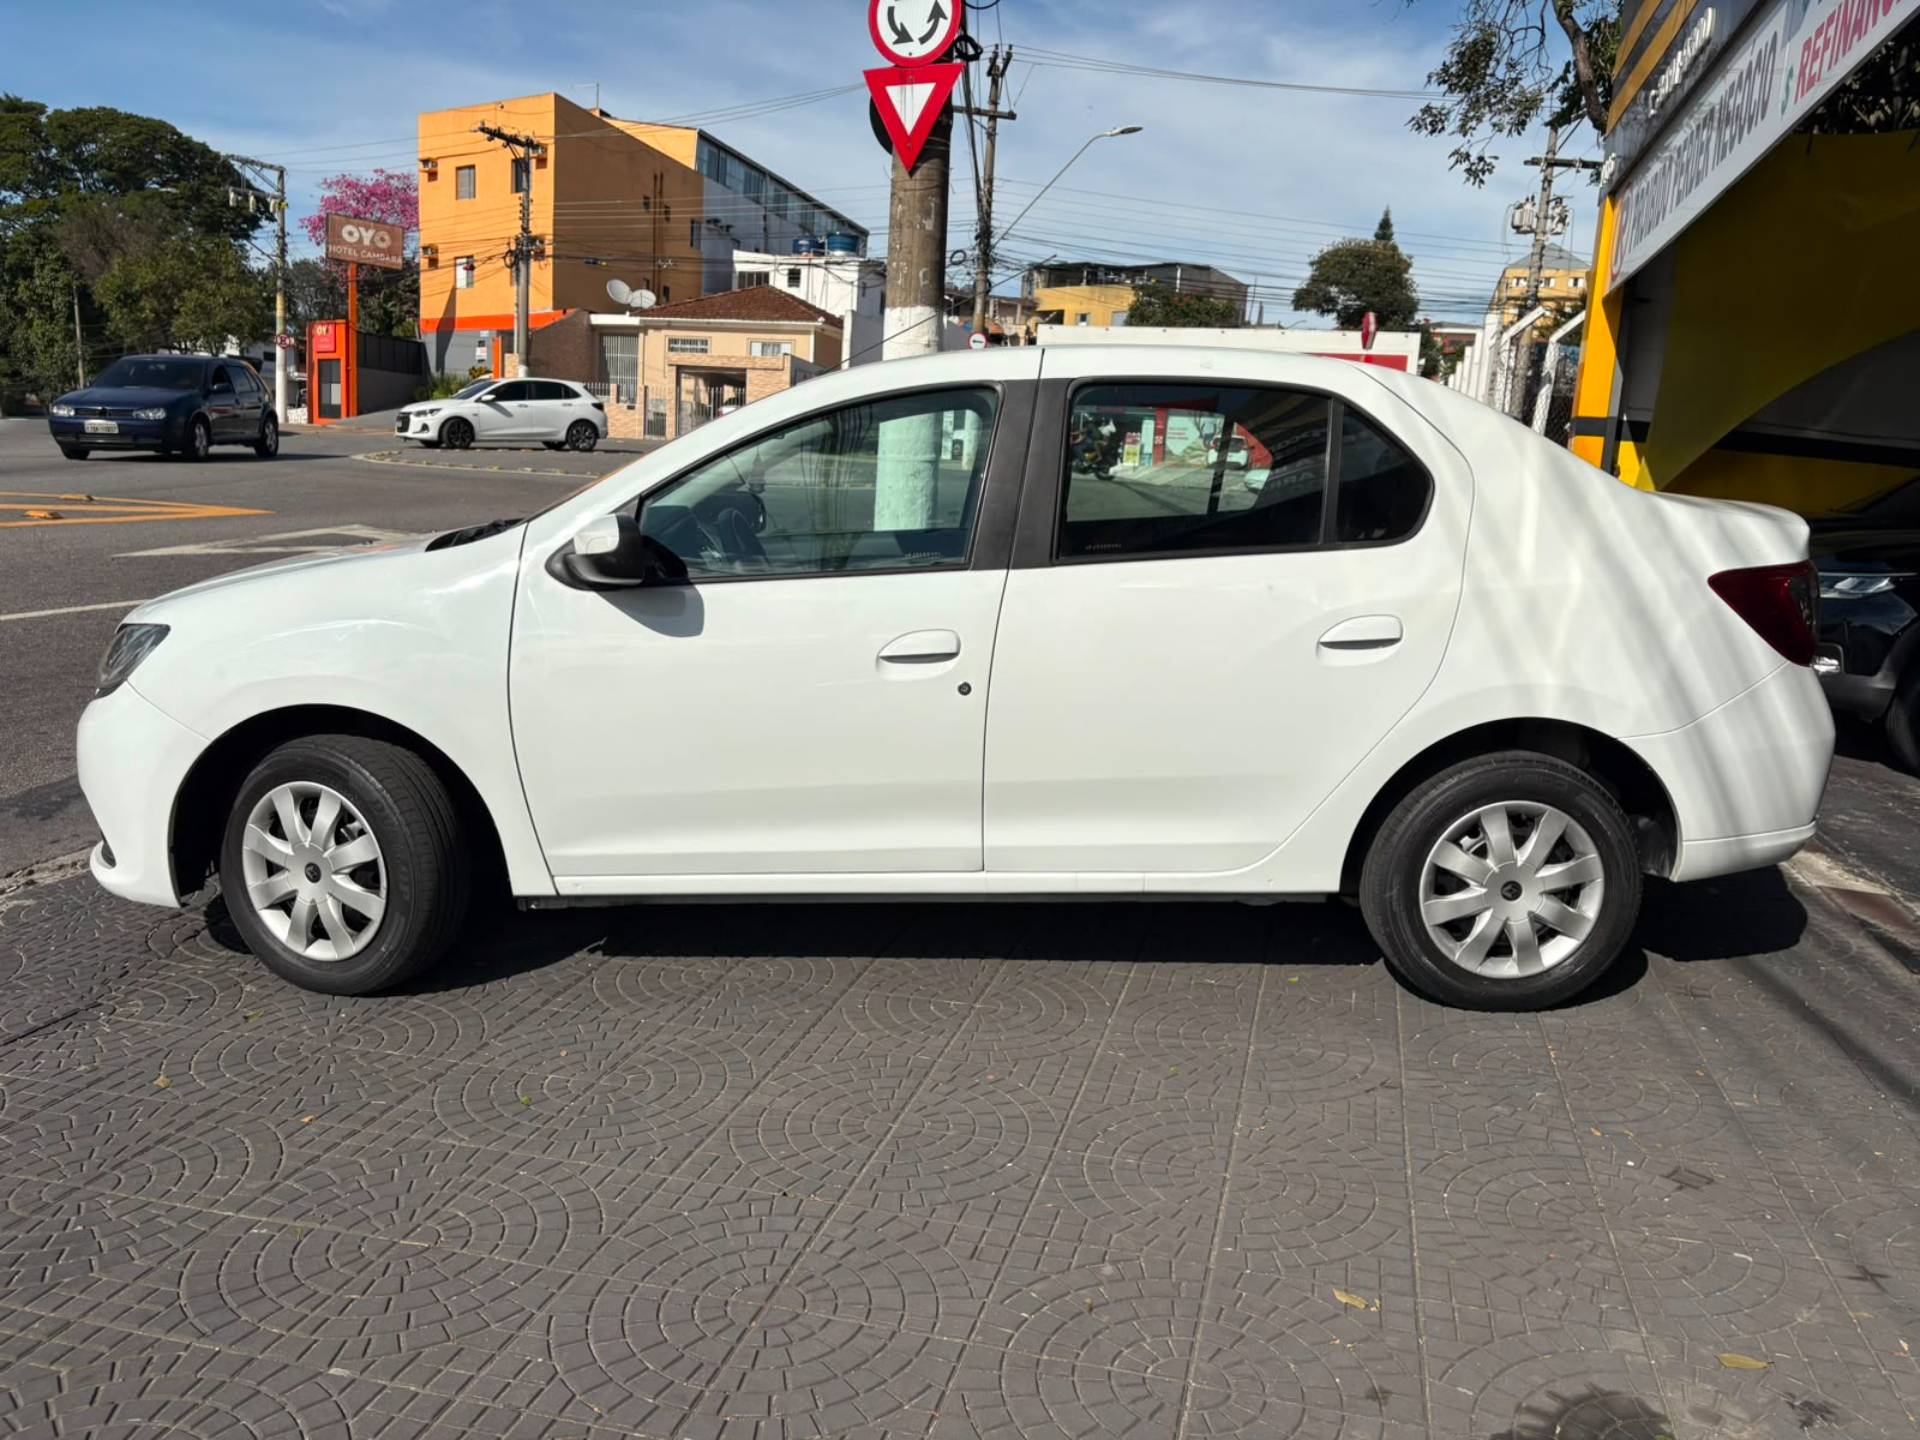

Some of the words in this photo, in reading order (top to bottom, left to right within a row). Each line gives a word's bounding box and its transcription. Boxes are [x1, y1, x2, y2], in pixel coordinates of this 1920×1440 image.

[1794, 0, 1894, 105] REFINAN
[1670, 104, 1715, 214] PERDER
[328, 245, 358, 257] HOTEL
[341, 224, 392, 249] OYO
